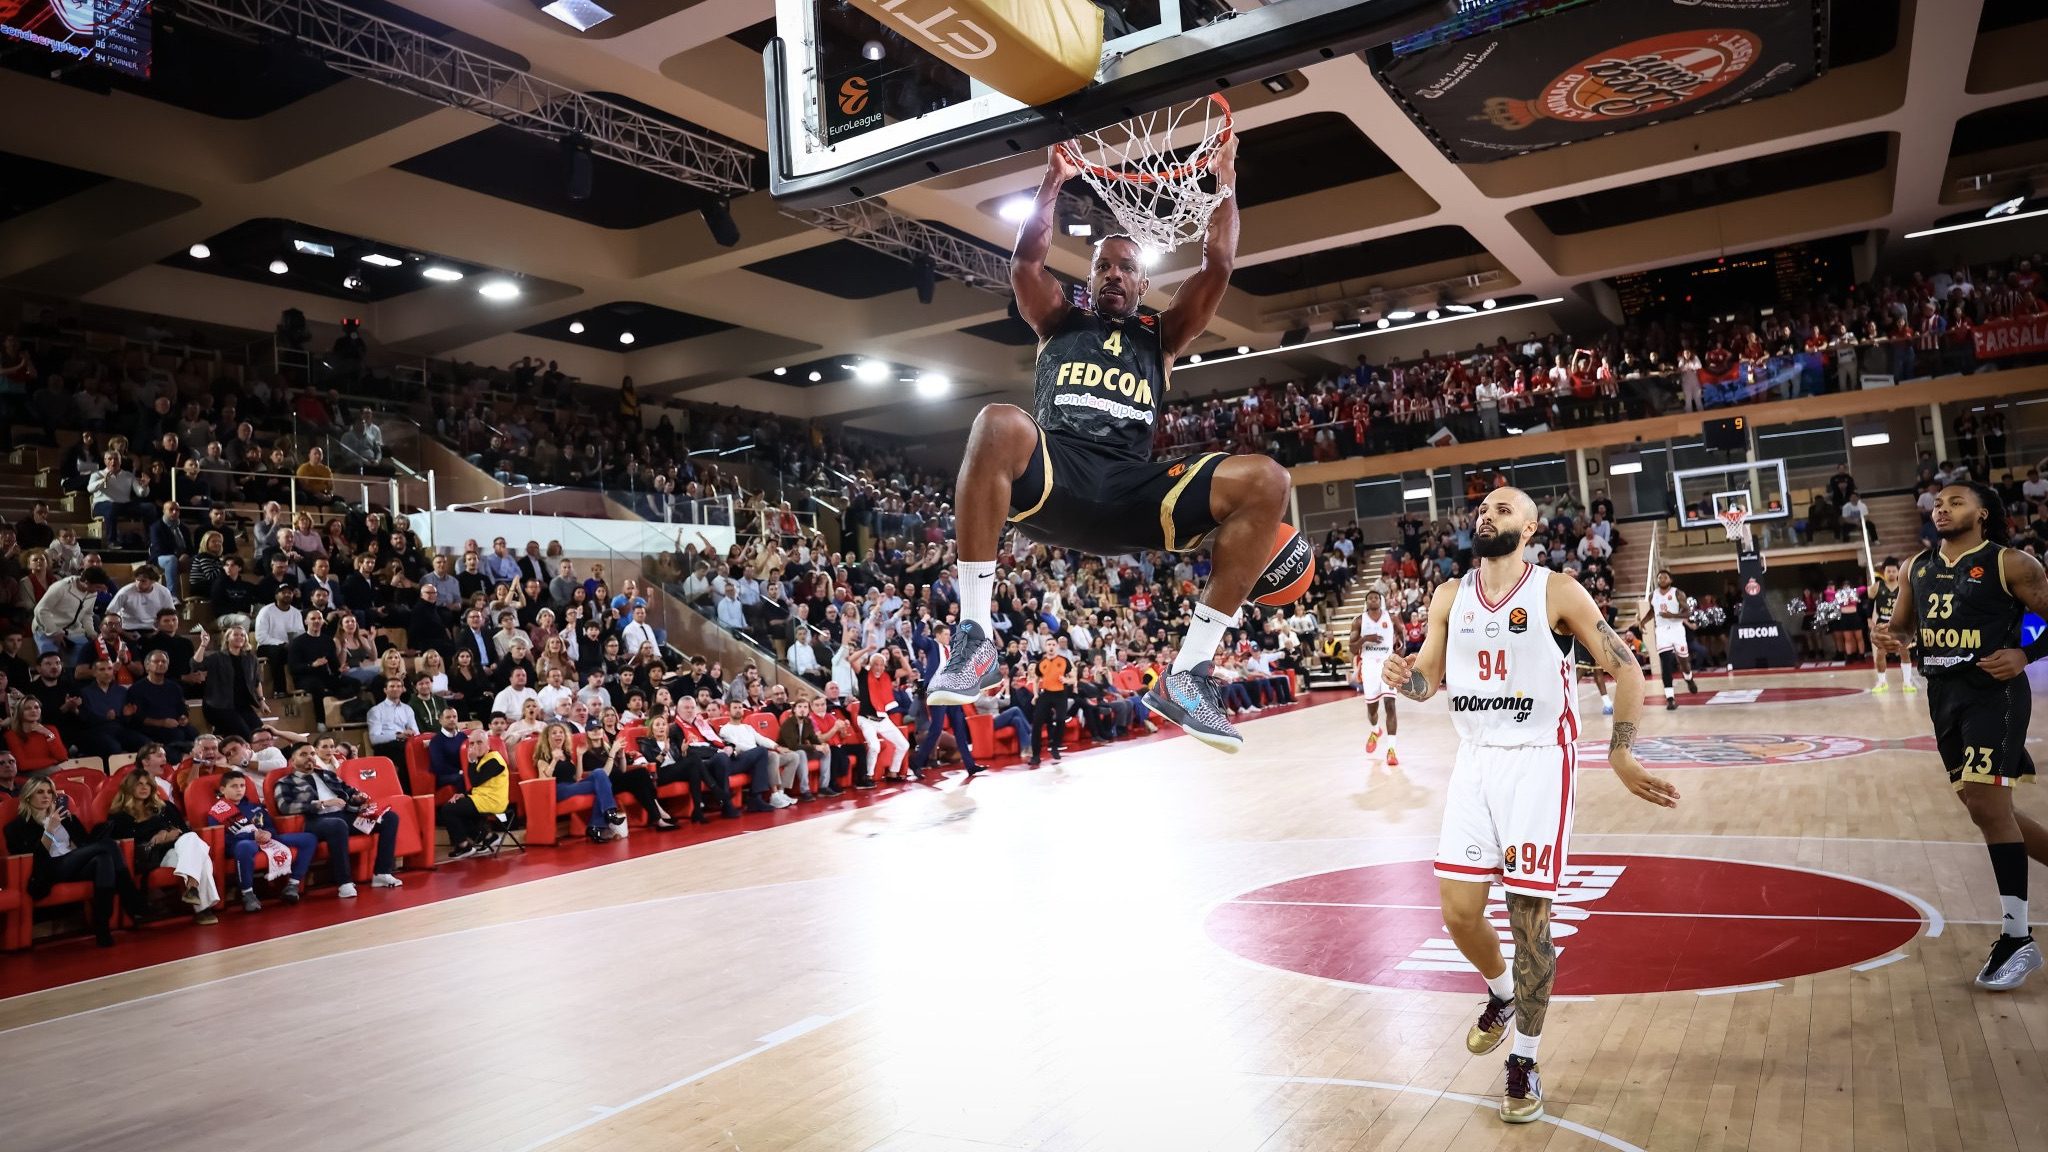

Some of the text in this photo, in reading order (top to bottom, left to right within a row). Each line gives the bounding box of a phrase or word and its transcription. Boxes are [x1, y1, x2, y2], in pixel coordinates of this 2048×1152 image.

[872, 0, 997, 60] ETI
[95, 53, 106, 62] 94
[829, 111, 882, 136] EuroLeague
[1103, 329, 1123, 357] 4
[1056, 362, 1156, 408] FEDCOM
[1055, 393, 1144, 419] zondacrypto
[1586, 458, 1600, 475] D
[1926, 592, 1955, 620] 23
[1738, 626, 1779, 639] FEDCOM
[1920, 628, 1981, 649] EDCOM
[1477, 650, 1508, 681] 94
[1452, 691, 1534, 712] 100xronia
[1513, 711, 1531, 723] .gr
[1963, 746, 1994, 775] 23
[1521, 842, 1553, 877] 94
